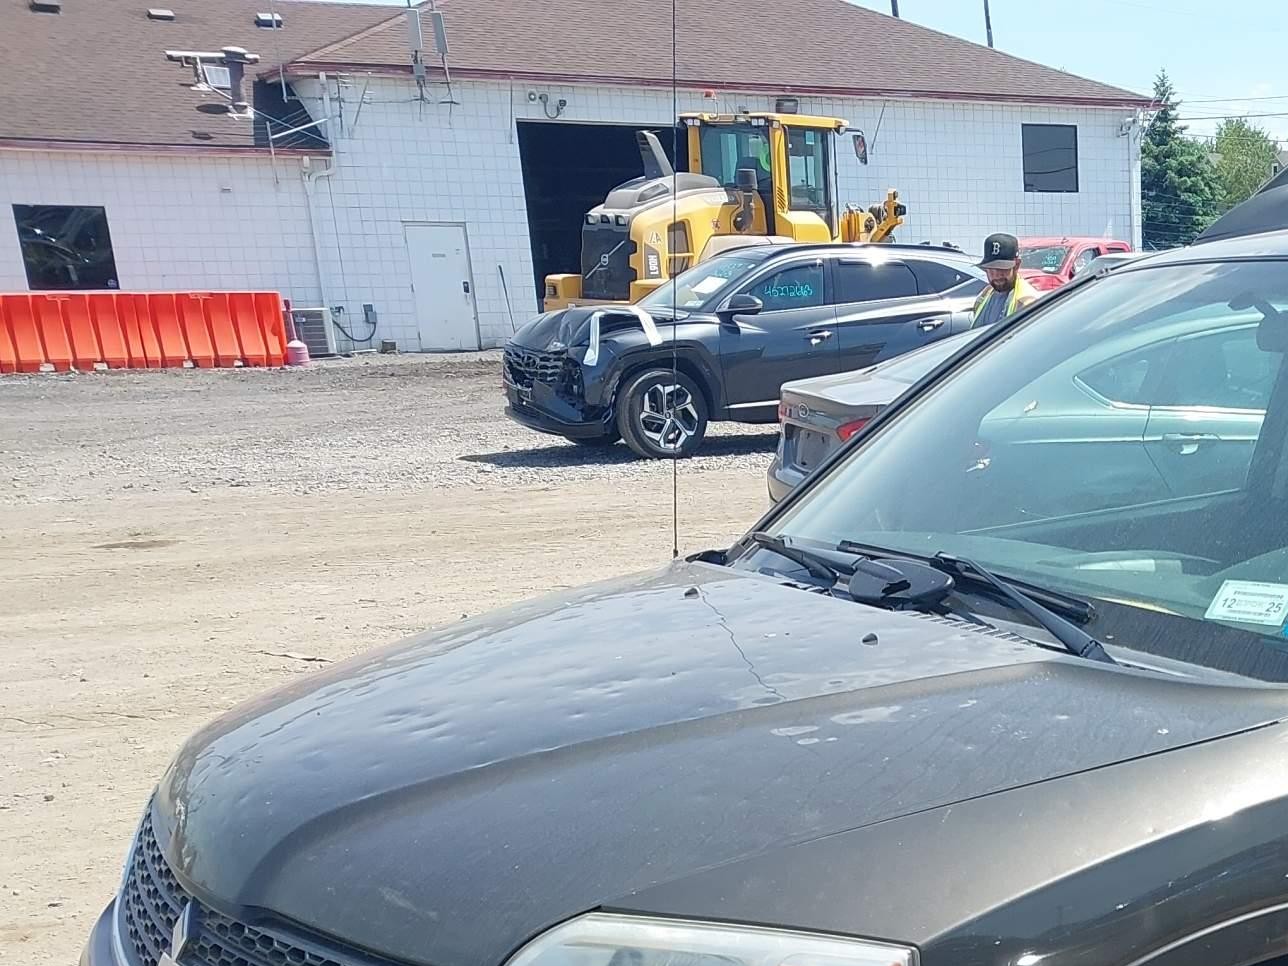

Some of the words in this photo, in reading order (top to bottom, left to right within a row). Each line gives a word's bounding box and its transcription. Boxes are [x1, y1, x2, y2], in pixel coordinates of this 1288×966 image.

[992, 242, 1001, 255] B
[1222, 598, 1237, 609] 12
[1265, 602, 1283, 614] 25
